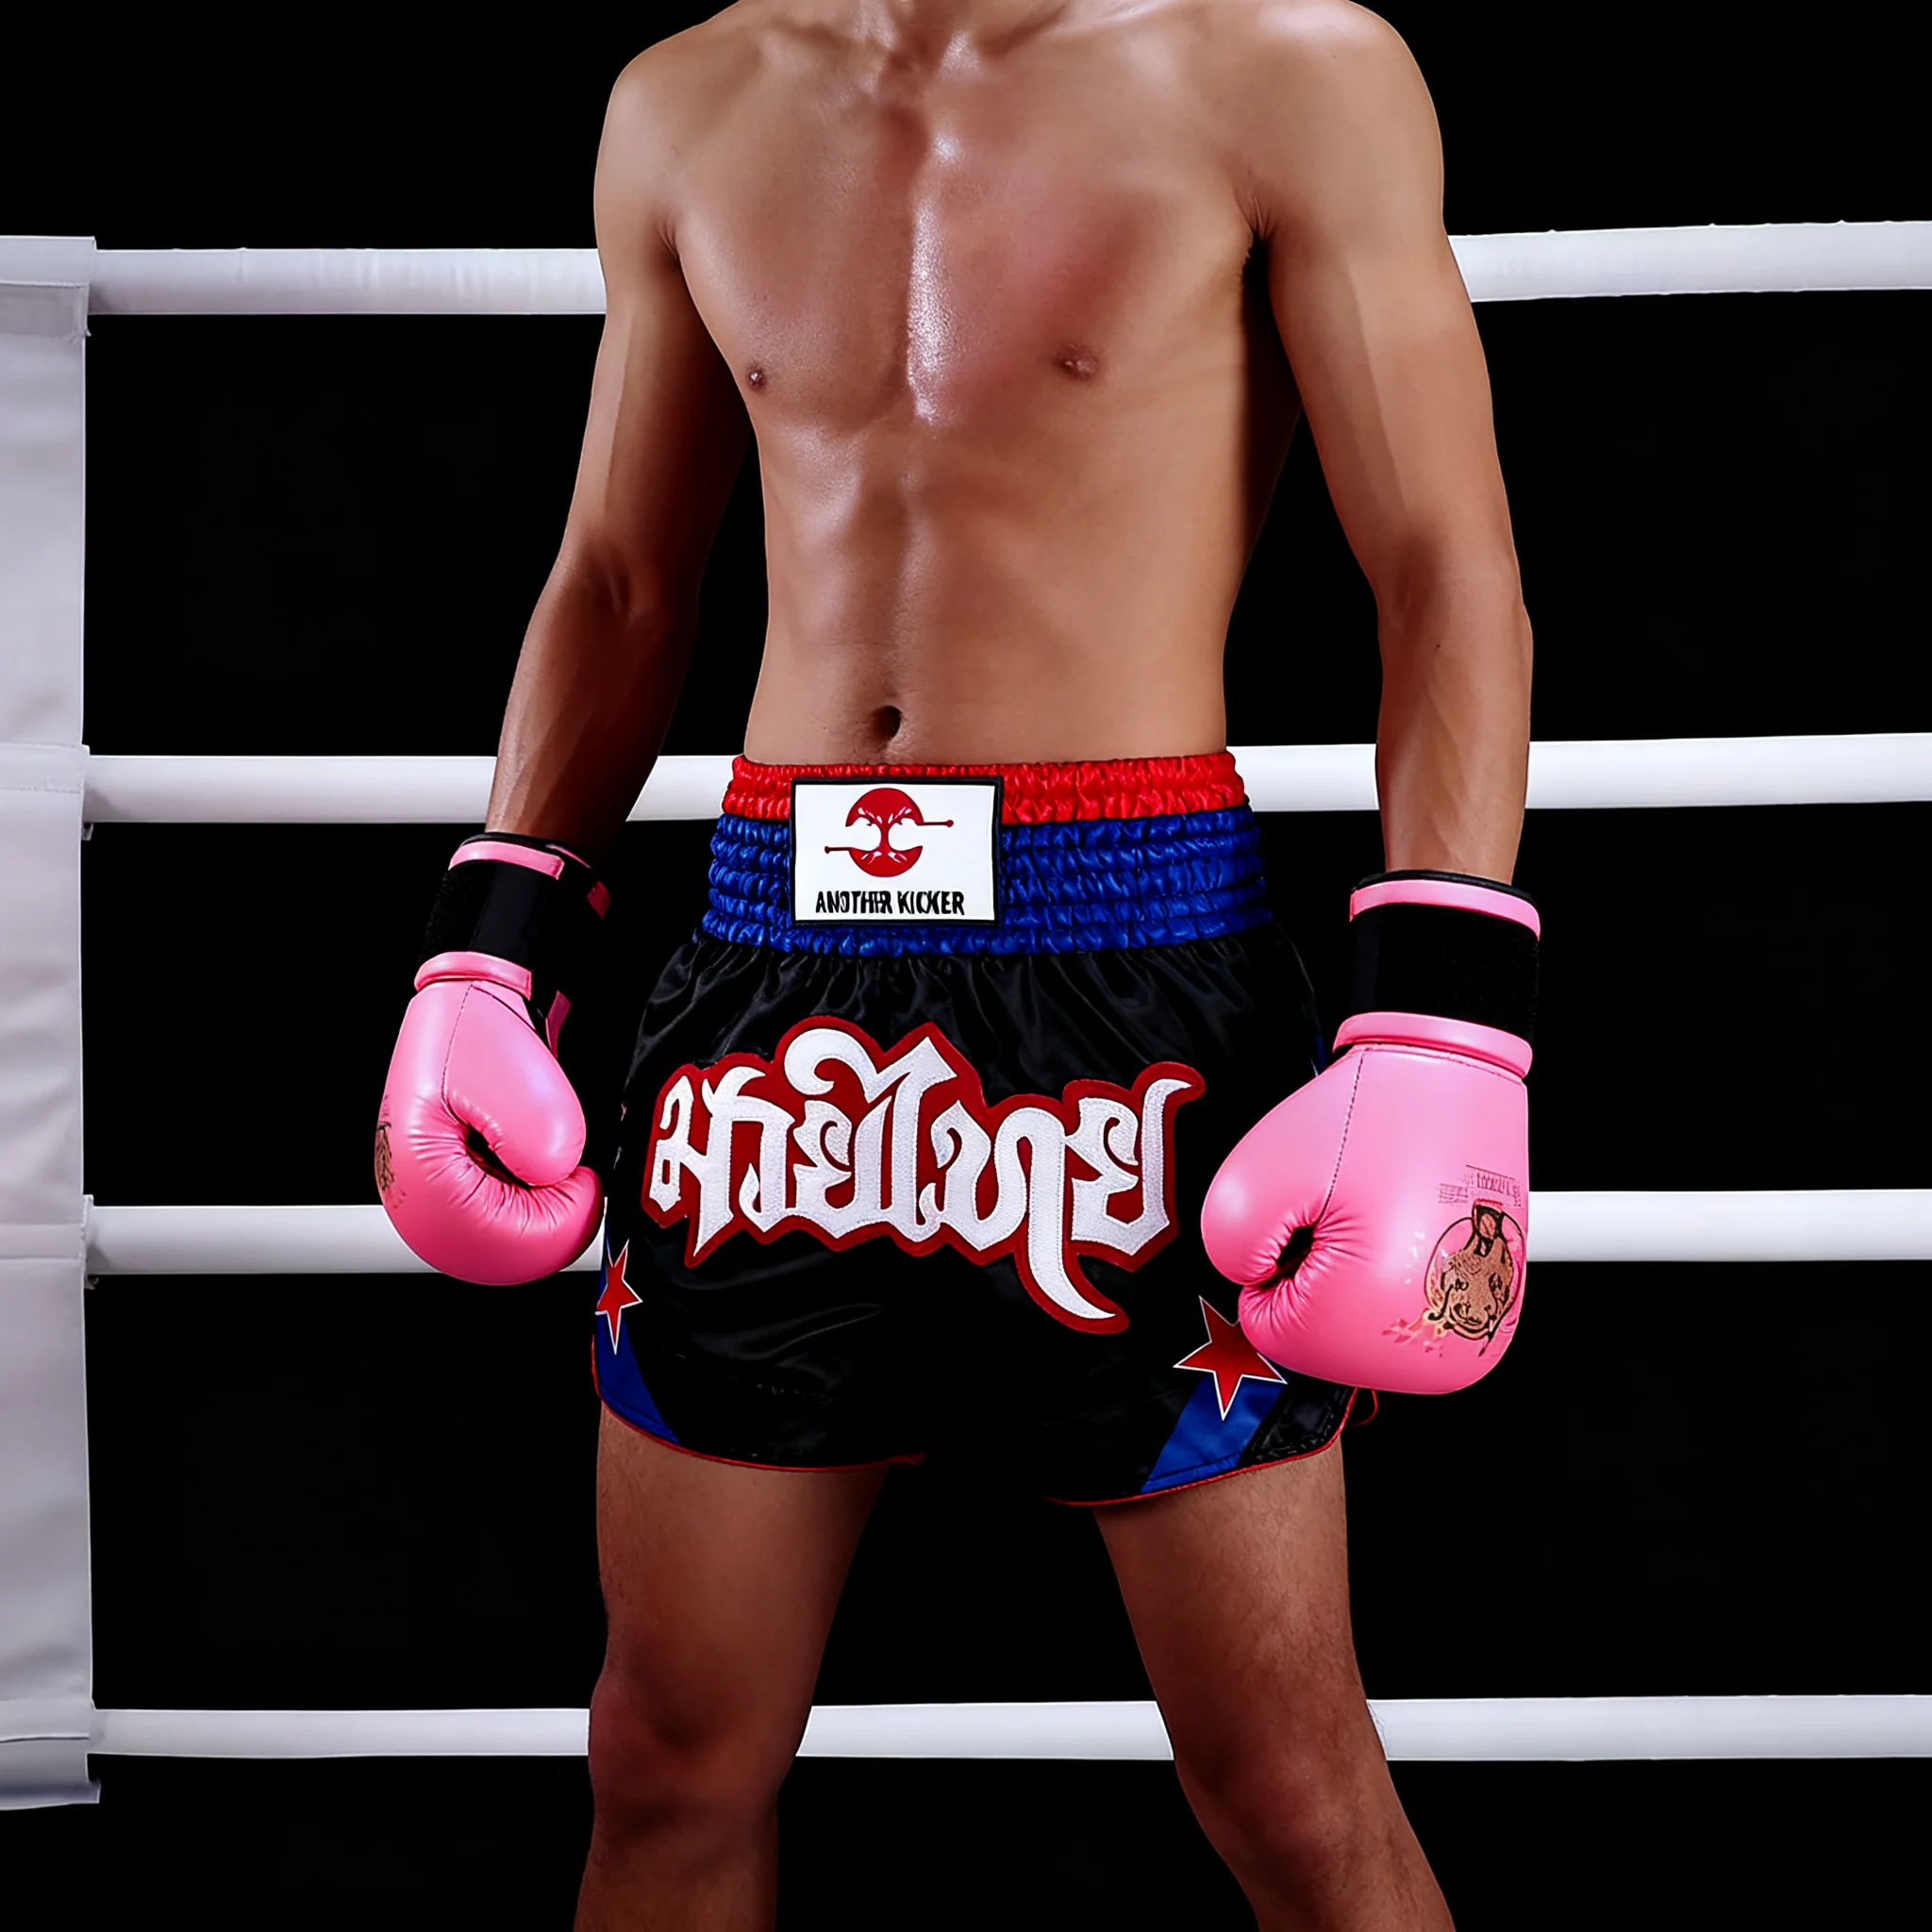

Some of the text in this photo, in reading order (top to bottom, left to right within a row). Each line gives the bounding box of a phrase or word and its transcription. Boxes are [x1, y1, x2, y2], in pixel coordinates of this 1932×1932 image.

[897, 891, 965, 915] KICKER
[649, 1027, 1192, 1320] มวยไทย
